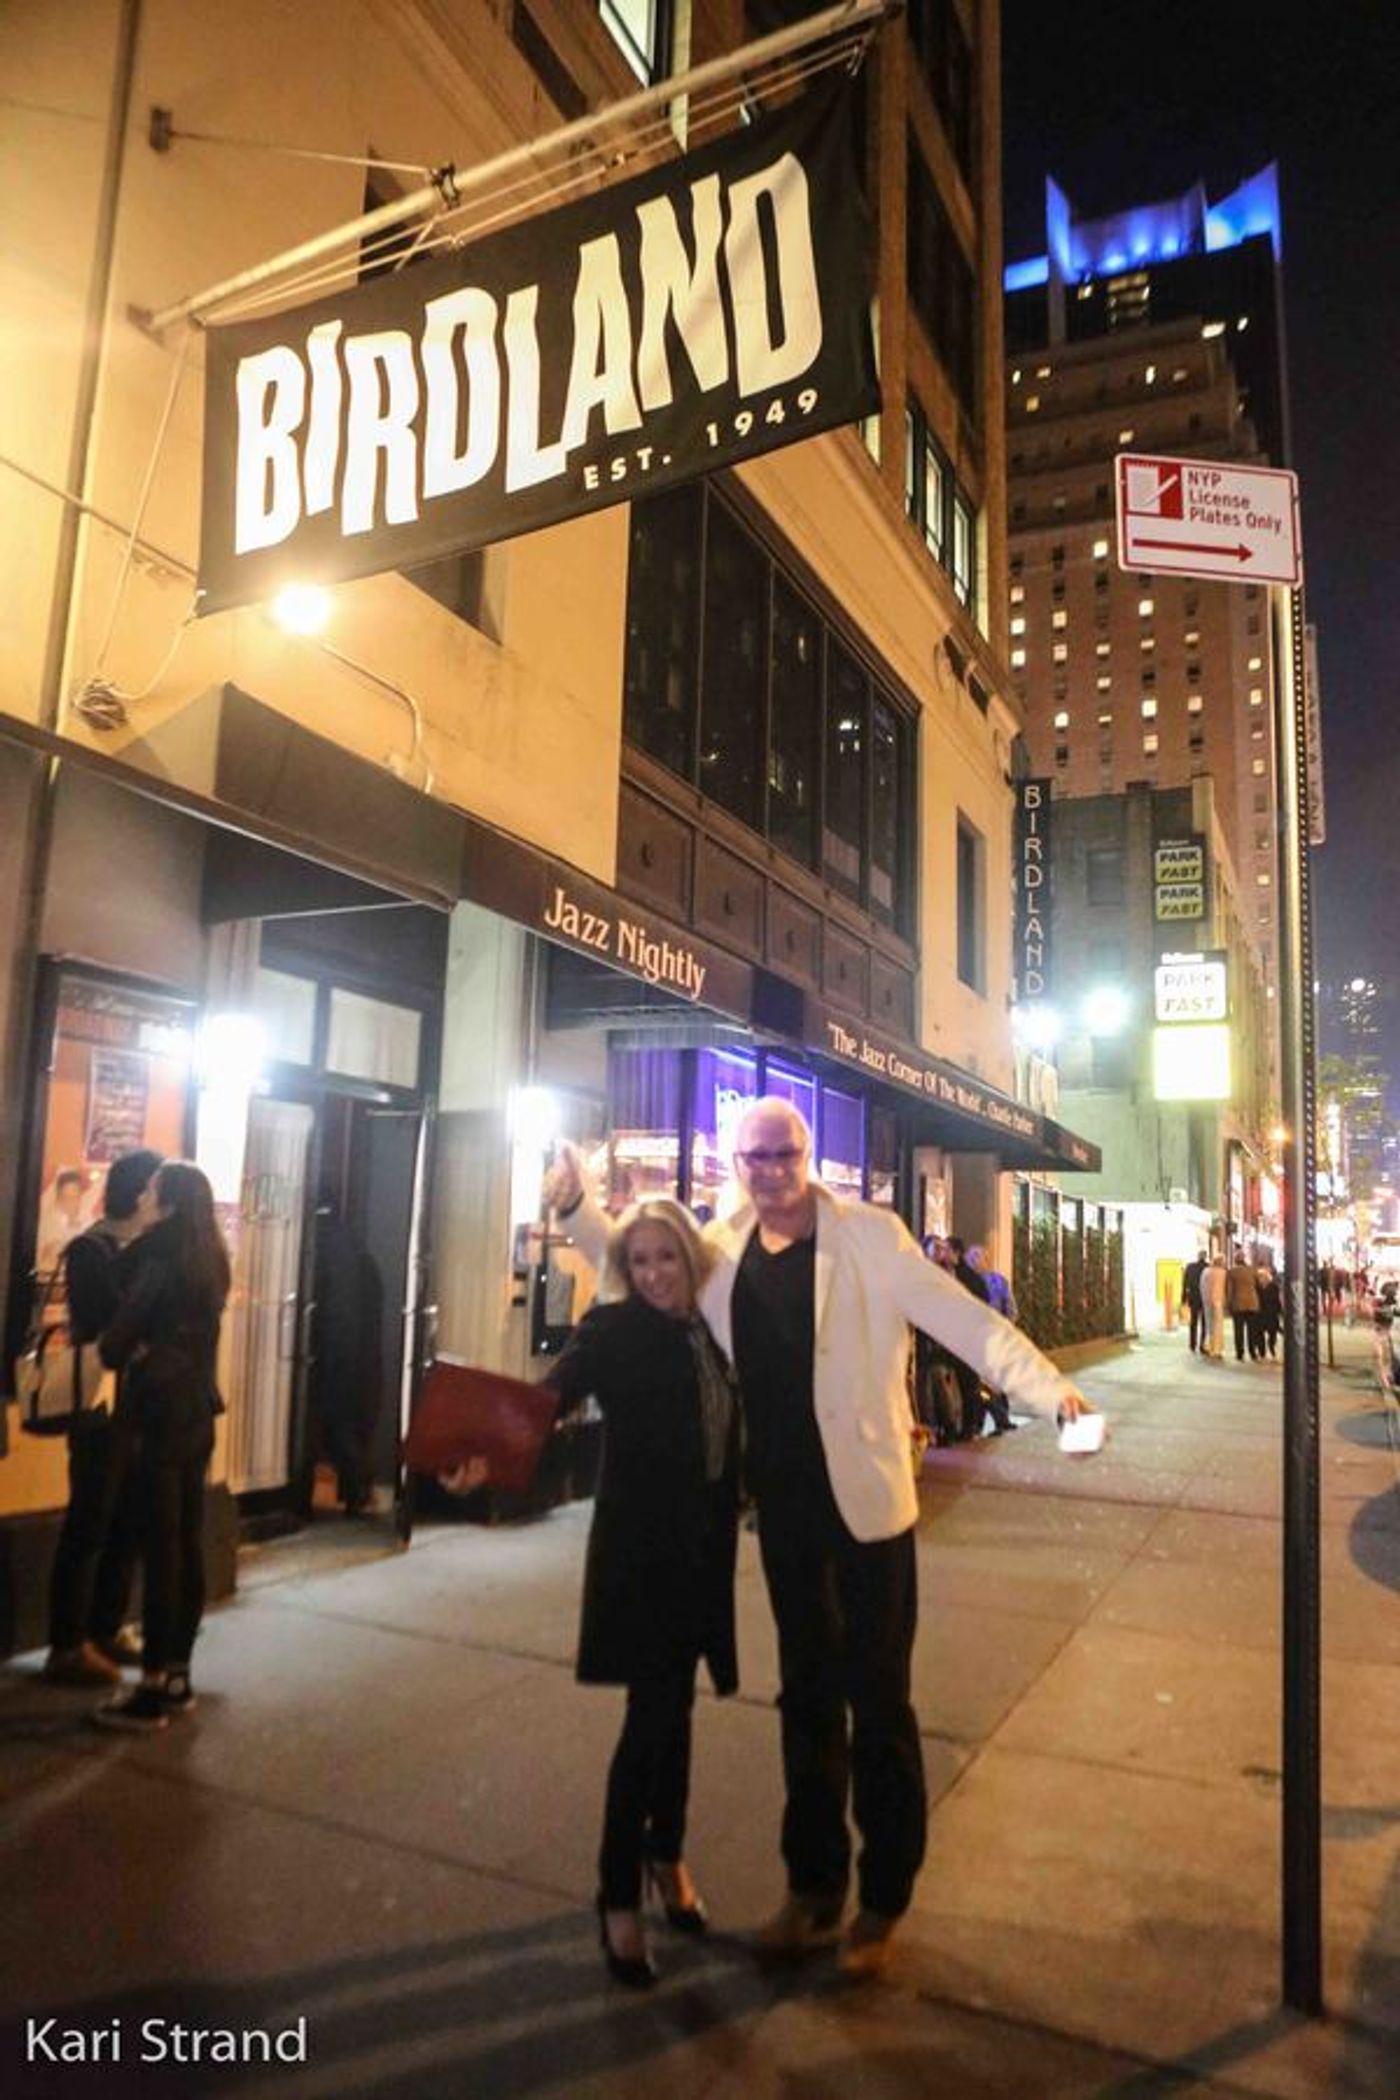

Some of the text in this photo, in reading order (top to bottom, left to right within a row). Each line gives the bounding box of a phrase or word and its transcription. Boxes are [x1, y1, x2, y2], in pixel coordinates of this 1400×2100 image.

[235, 152, 823, 555] BIRDLAND
[583, 389, 818, 490] EST. 1949
[1188, 470, 1221, 487] NYP
[1189, 488, 1250, 510] License
[1190, 506, 1282, 536] Plates Only
[1159, 850, 1199, 862] PARK
[1160, 865, 1200, 878] FAST
[1023, 785, 1045, 996] BIRDLAND
[1159, 886, 1199, 899] PARK
[1160, 902, 1200, 915] FAST
[544, 886, 707, 999] Jazz Nightly
[858, 1039, 886, 1073] Jazz
[887, 1052, 923, 1089] Corner
